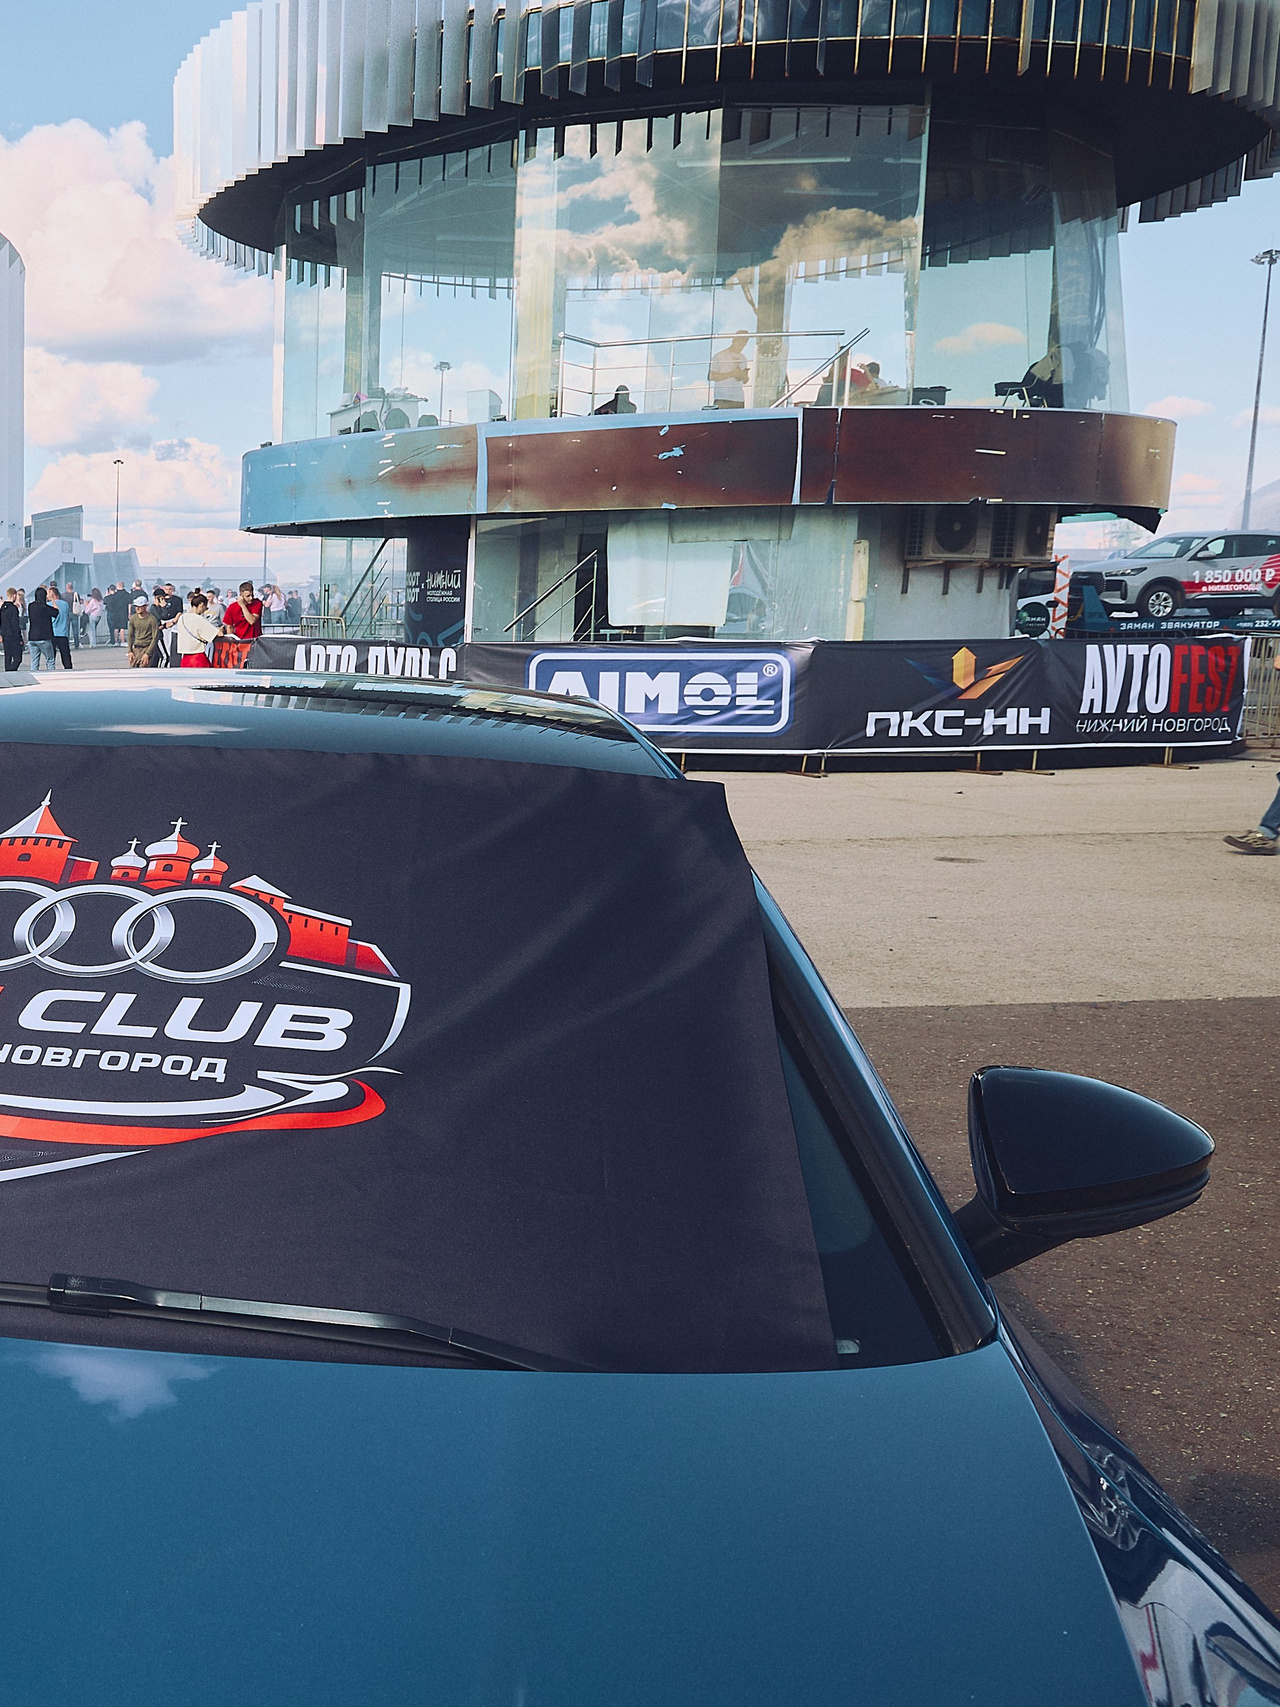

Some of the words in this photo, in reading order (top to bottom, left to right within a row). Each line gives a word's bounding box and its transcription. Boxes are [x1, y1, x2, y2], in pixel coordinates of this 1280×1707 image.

[1192, 569, 1201, 584] 1
[1204, 569, 1232, 584] 850
[1234, 568, 1262, 583] 000
[1120, 622, 1155, 630] ЗАМАН
[1160, 620, 1221, 630] ЭВАКУАТОР
[1079, 643, 1241, 714] AVTOFEST
[866, 707, 1051, 738] ПКС-НН
[1076, 715, 1148, 733] НИЖНИЙ
[1151, 717, 1231, 733] НОВГОРОД
[17, 989, 354, 1052] CLUB
